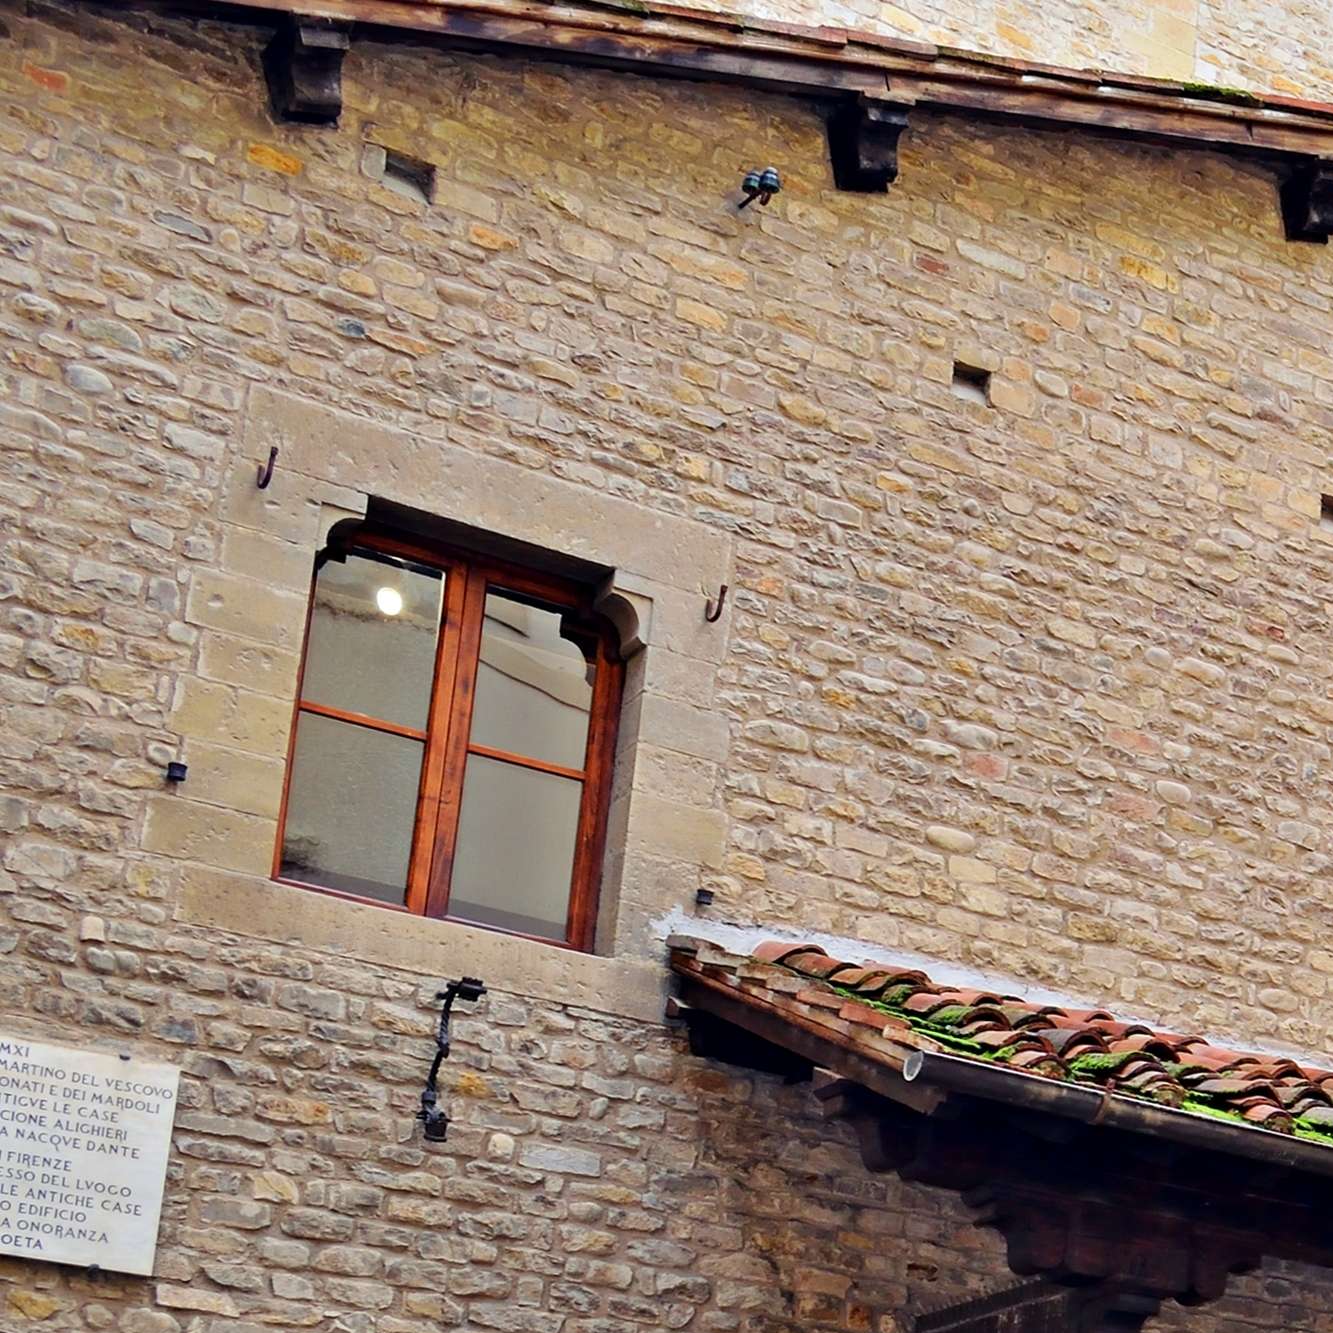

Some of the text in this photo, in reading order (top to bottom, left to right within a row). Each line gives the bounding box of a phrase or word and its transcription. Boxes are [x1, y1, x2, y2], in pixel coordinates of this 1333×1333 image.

[0, 1058, 174, 1101] MARTINO DEL VESCOVO
[0, 1075, 161, 1115] ONATI E DEI MARDOLI
[0, 1092, 120, 1124] TIGVE LE CASE
[0, 1108, 129, 1142] CIONE ALIGHIERI
[0, 1126, 141, 1160] A NACQVE DANTE
[6, 1151, 73, 1173] FIRENZE
[41, 1172, 70, 1189] DEL
[0, 1183, 143, 1217] LE ANTICHE CASE
[0, 1199, 88, 1224] O EDIFICIO
[0, 1217, 110, 1244] A ONORANZA
[0, 1233, 44, 1251] OETA
